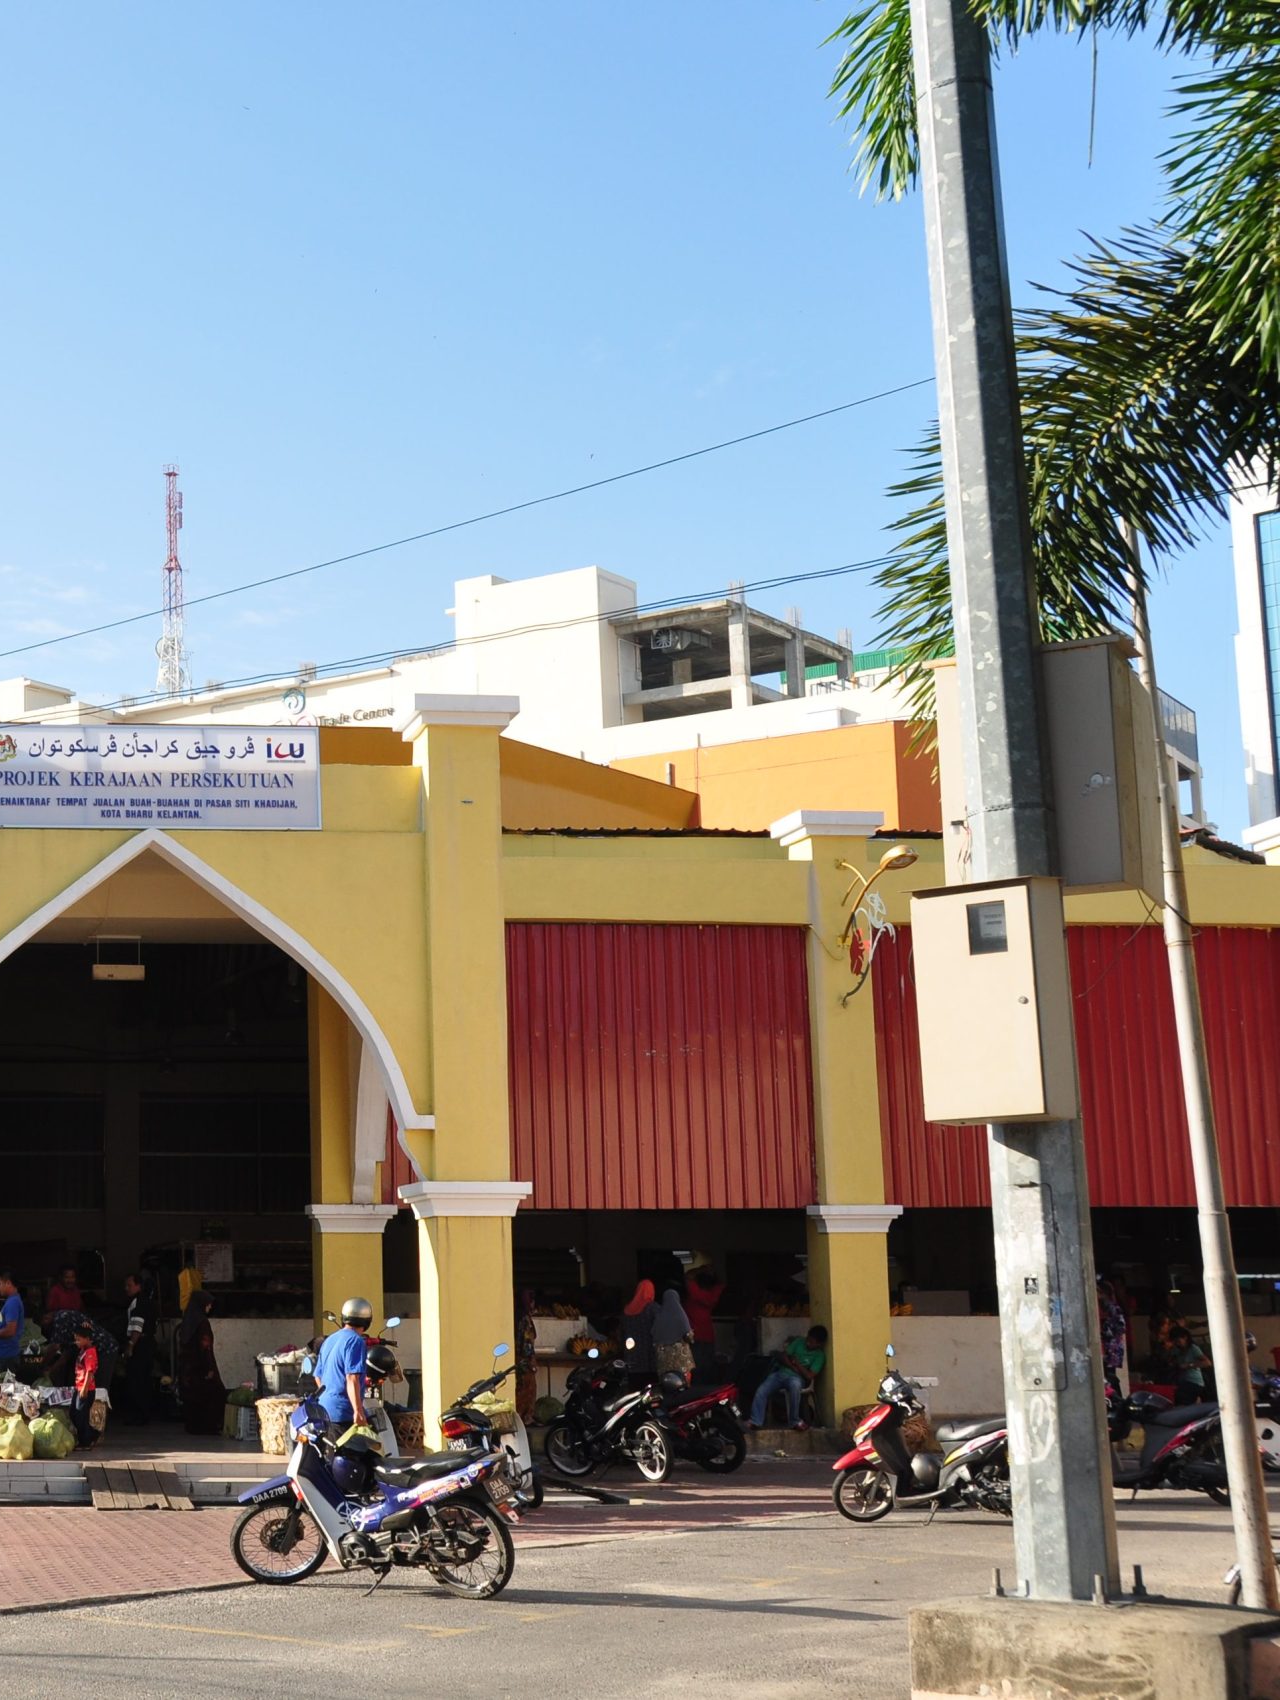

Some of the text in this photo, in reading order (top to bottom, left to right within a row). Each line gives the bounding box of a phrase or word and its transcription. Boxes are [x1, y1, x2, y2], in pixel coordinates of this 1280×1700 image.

[69, 771, 163, 787] KERAJAAN
[170, 772, 294, 789] PERSEKUTUAN
[56, 797, 88, 807] TEMPAT
[92, 798, 125, 808] JUALAN
[129, 798, 190, 808] BUAH-BUAHAN
[194, 799, 203, 808] DI
[206, 799, 232, 808] PASAR
[235, 799, 251, 808] SITI
[100, 809, 203, 820] KOTA BHARU KELANTAN.
[489, 1478, 504, 1491] DAA
[492, 1484, 510, 1499] 2709
[252, 1485, 288, 1504] DAA 2709
